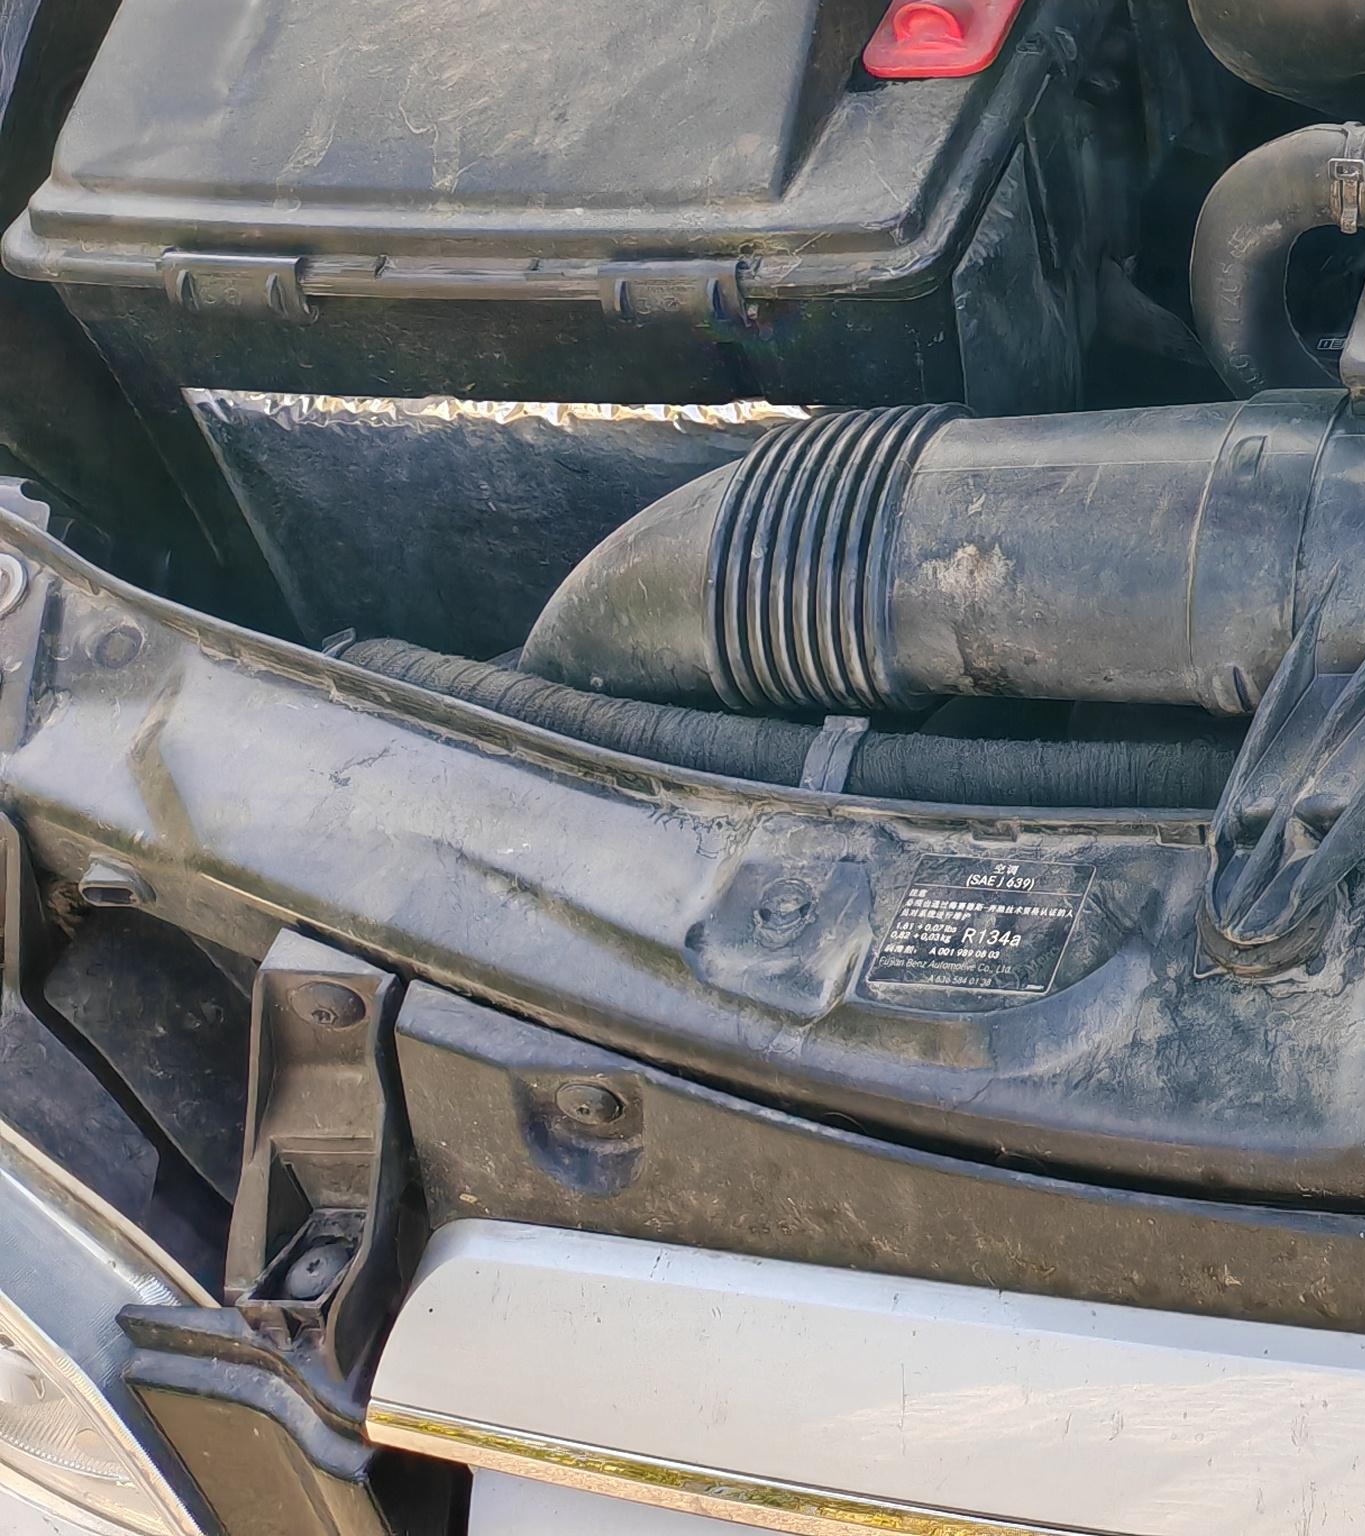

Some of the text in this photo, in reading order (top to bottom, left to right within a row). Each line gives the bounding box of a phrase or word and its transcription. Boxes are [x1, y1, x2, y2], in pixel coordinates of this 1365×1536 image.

[991, 863, 1020, 875] 空调
[964, 874, 998, 888] (SAE
[1004, 876, 1036, 891] 639)
[960, 927, 1024, 947] R134a
[937, 947, 955, 956] 001
[955, 948, 975, 957] 989
[904, 958, 928, 968] Benz
